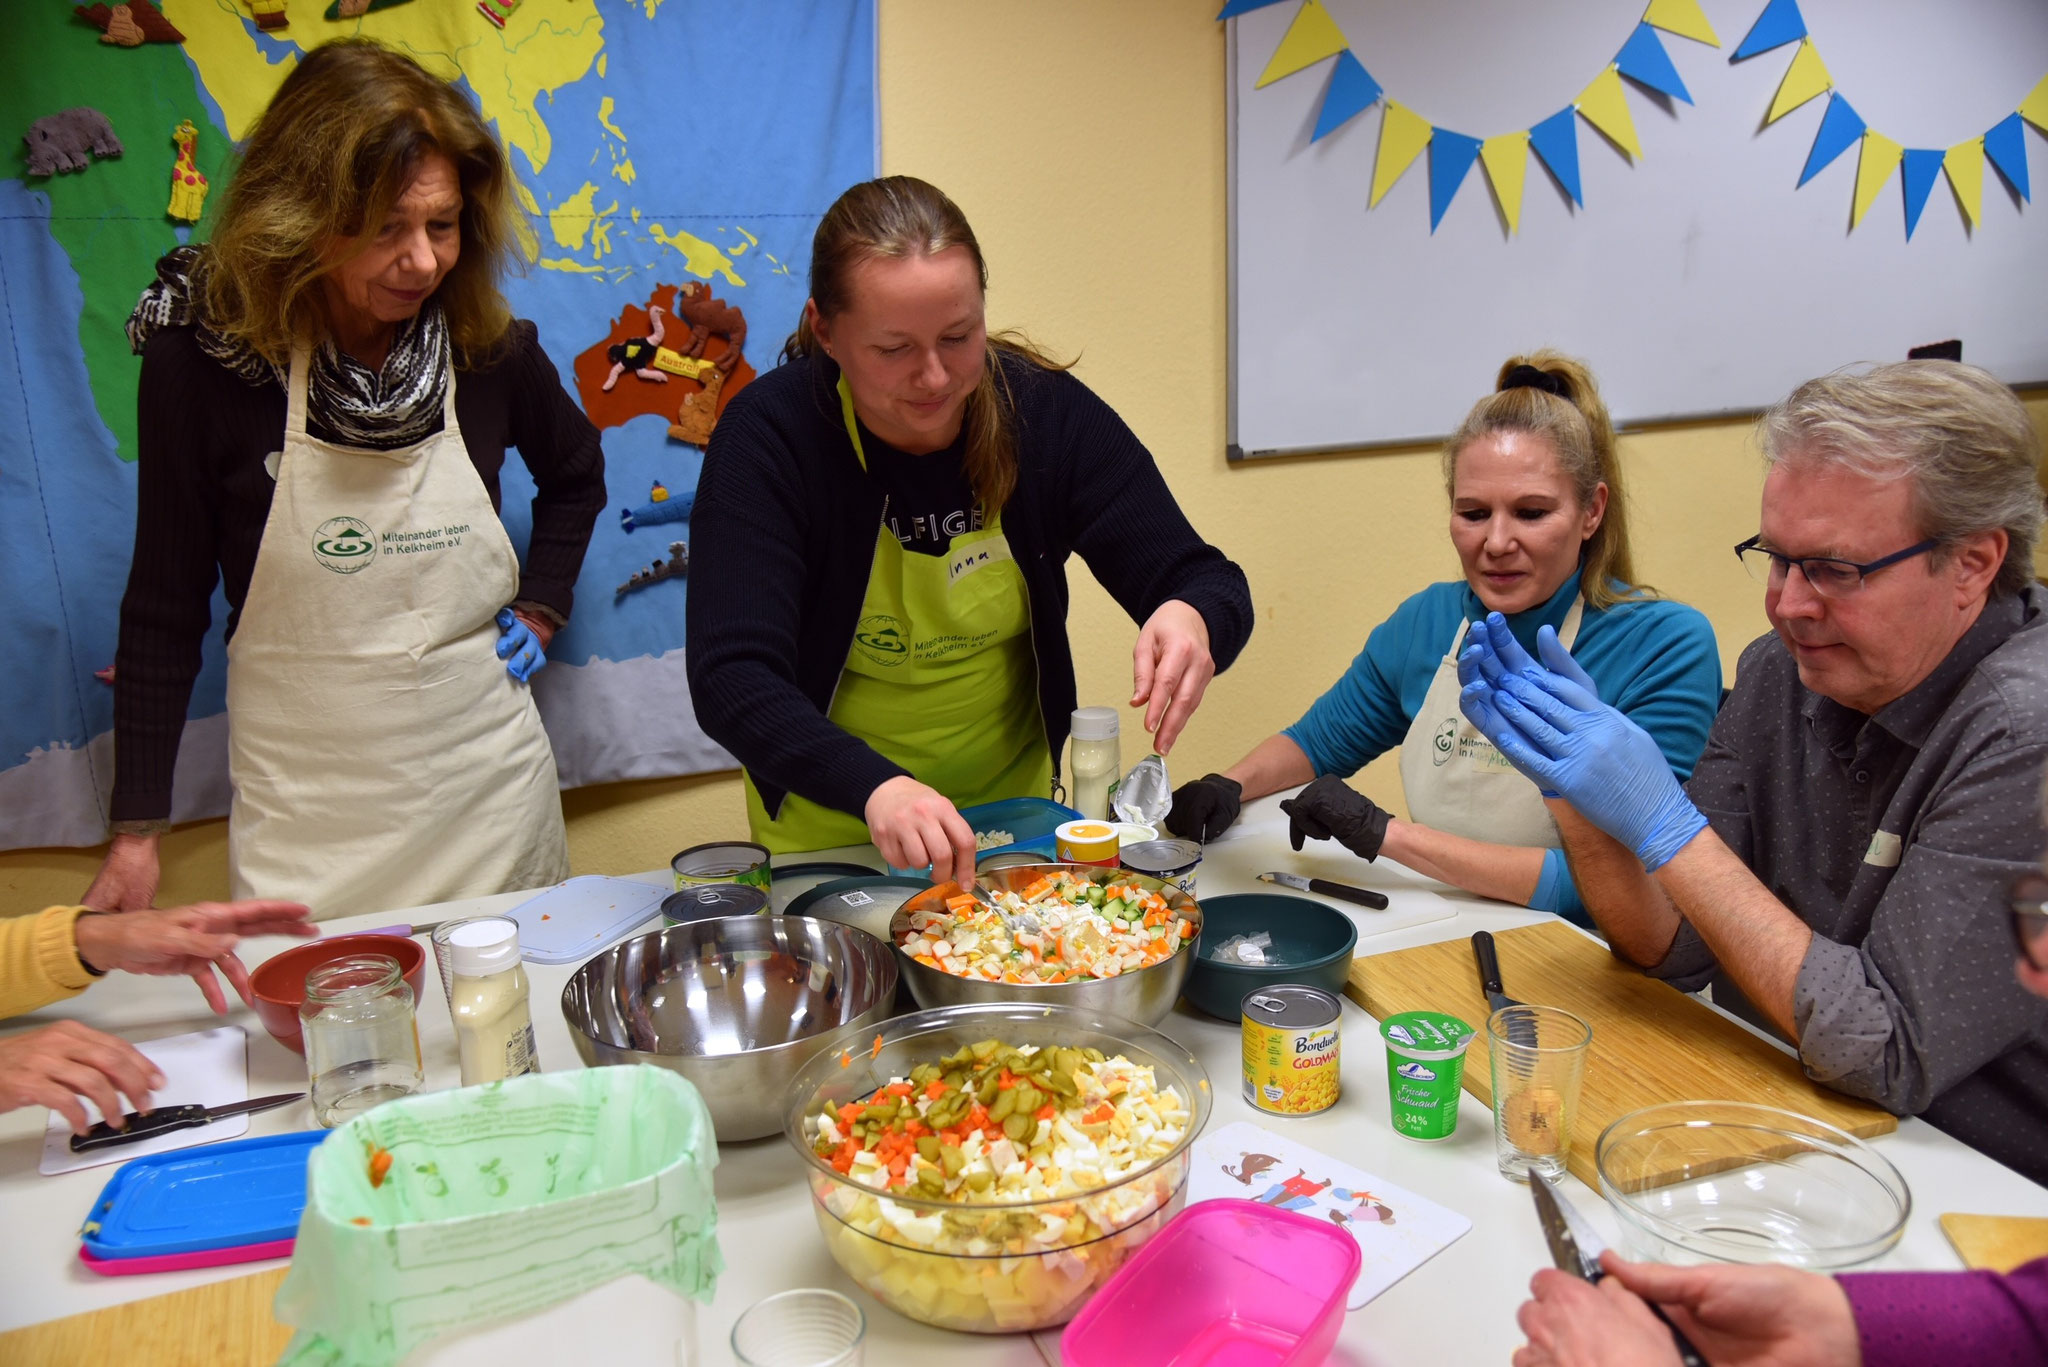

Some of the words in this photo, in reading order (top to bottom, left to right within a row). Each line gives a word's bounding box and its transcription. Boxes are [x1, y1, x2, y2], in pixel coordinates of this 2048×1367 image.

[660, 354, 700, 374] Australi
[382, 529, 442, 543] Miteinander
[444, 524, 470, 536] leben
[383, 546, 393, 555] in
[396, 540, 445, 554] Kelkheim
[447, 536, 462, 547] e.V.
[949, 551, 989, 578] Inna
[914, 634, 969, 651] Miteinander
[971, 629, 998, 642] leben
[925, 642, 968, 659] Kelkheim
[1395, 1090, 1440, 1108] Schmand
[1401, 1084, 1432, 1097] Frischer
[1405, 1113, 1428, 1126] 24%
